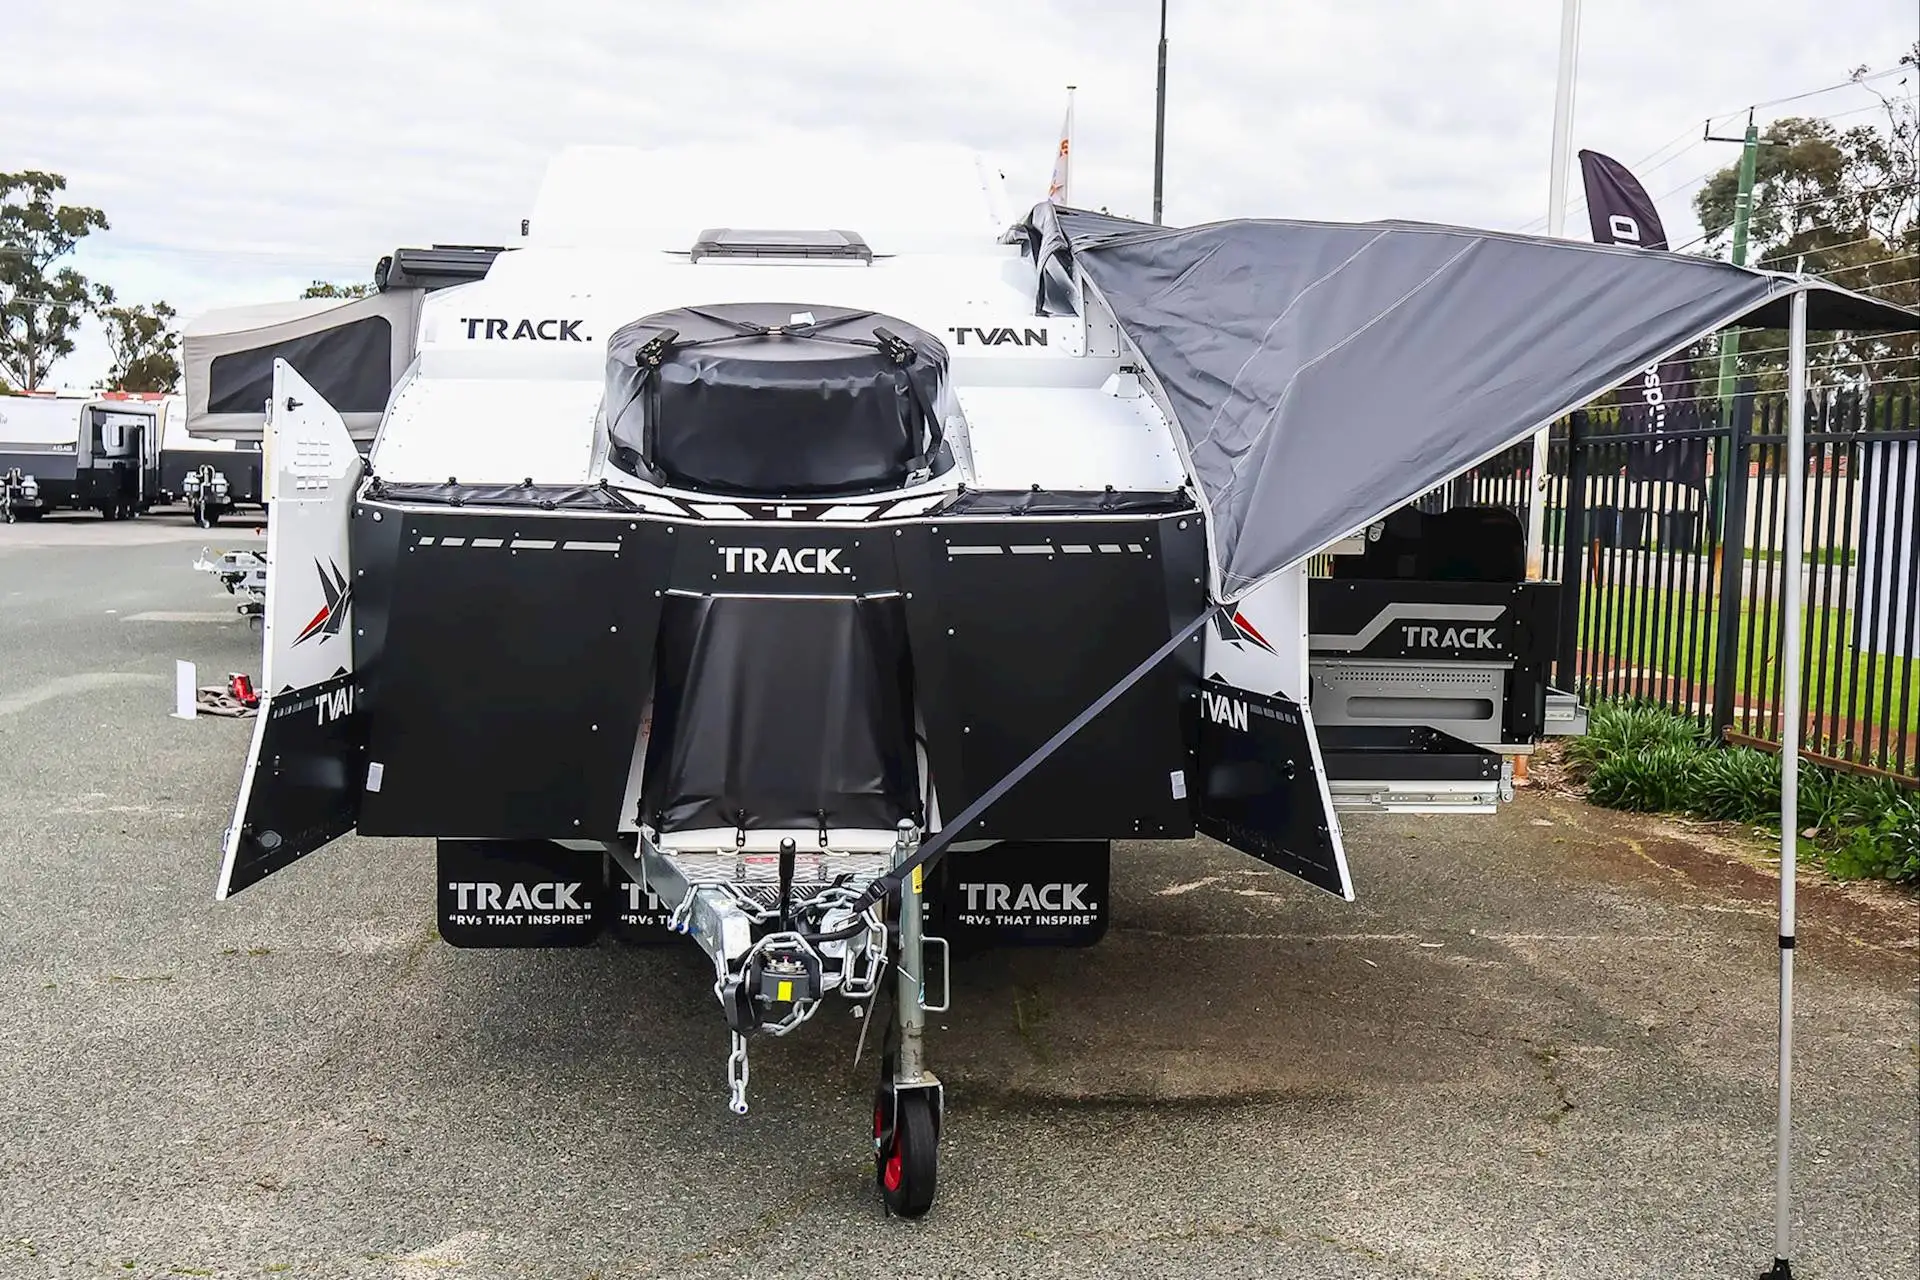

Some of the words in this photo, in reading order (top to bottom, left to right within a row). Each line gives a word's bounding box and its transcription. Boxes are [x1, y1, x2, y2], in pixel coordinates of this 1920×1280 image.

[460, 318, 592, 342] TRACK.
[948, 327, 1047, 346] TVAN
[718, 547, 850, 573] TRACK.
[1402, 626, 1502, 648] TRACK.
[449, 882, 592, 910] TRACK.
[959, 883, 1098, 910] TRACK.
[487, 914, 523, 925] THAT
[996, 915, 1031, 925] THAT
